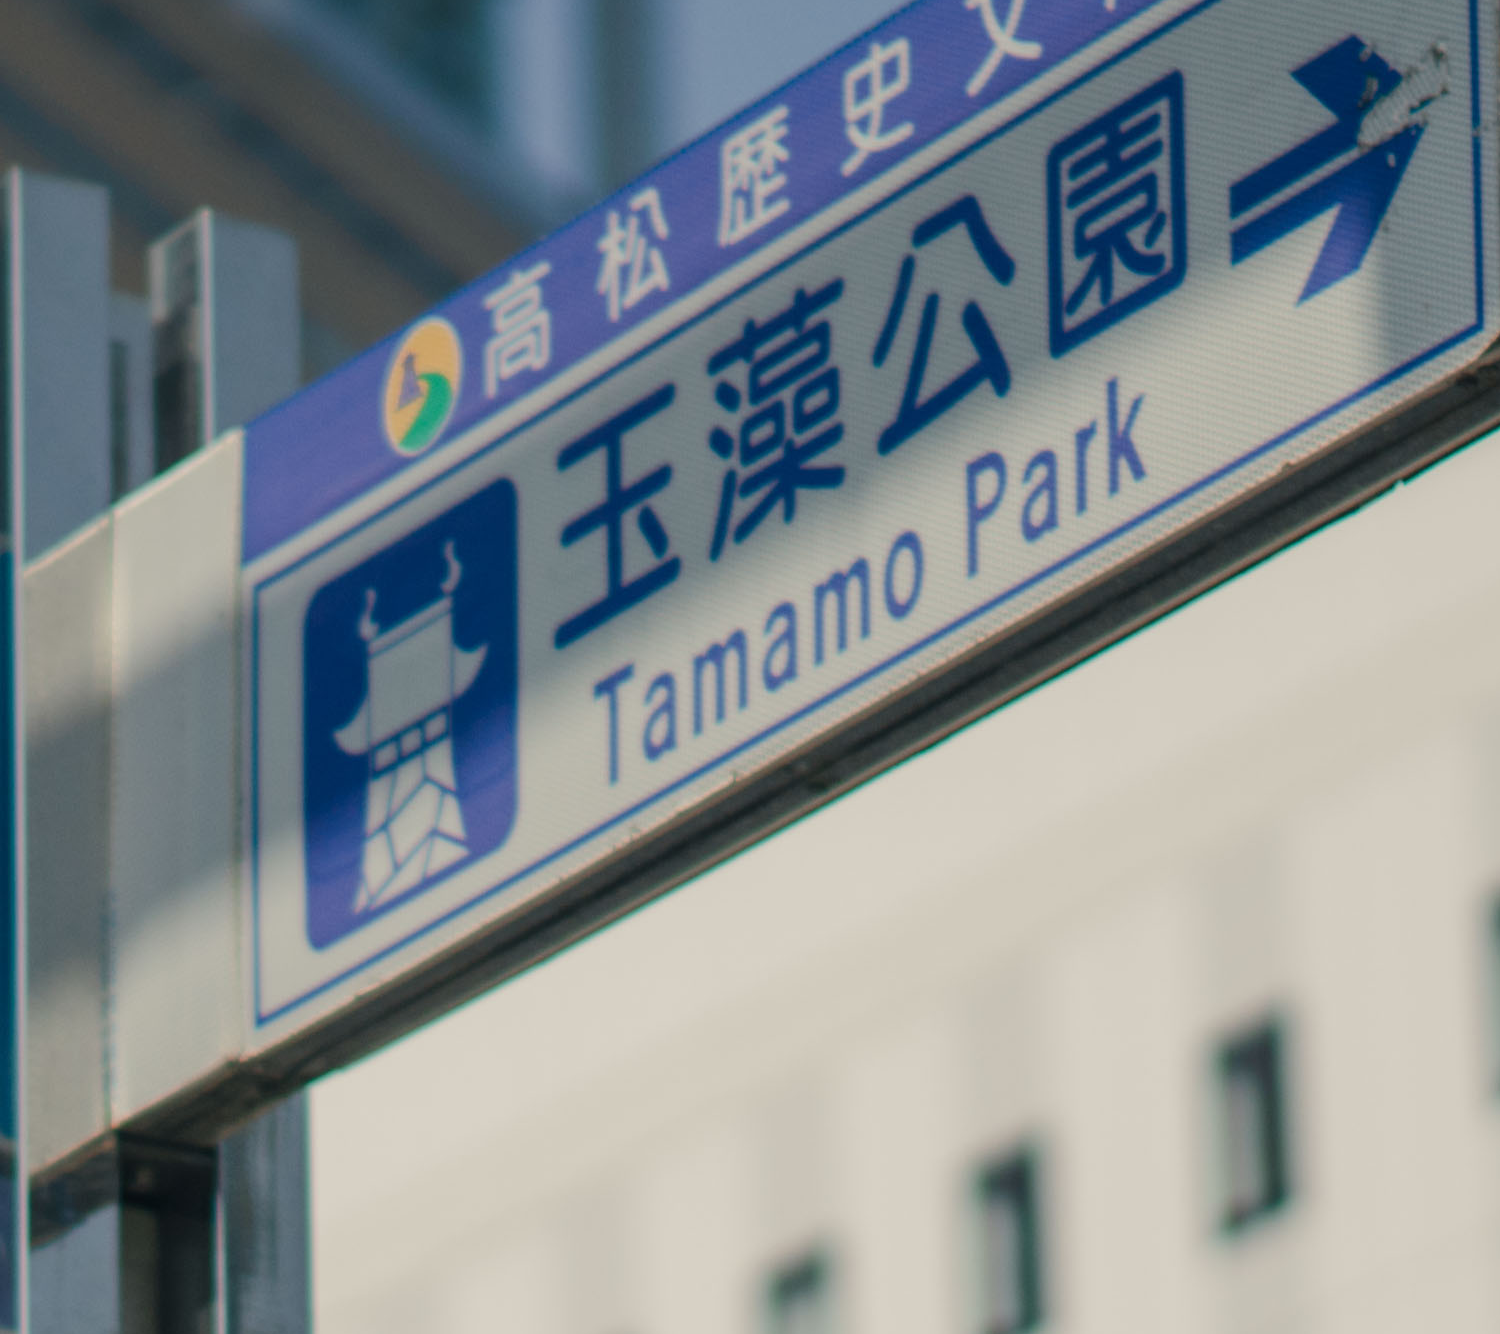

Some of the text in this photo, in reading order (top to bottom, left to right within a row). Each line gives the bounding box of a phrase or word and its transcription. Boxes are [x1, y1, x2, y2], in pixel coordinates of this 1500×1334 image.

[554, 71, 1188, 650] 玉藻公園
[592, 378, 1146, 785] Tamamo Park
